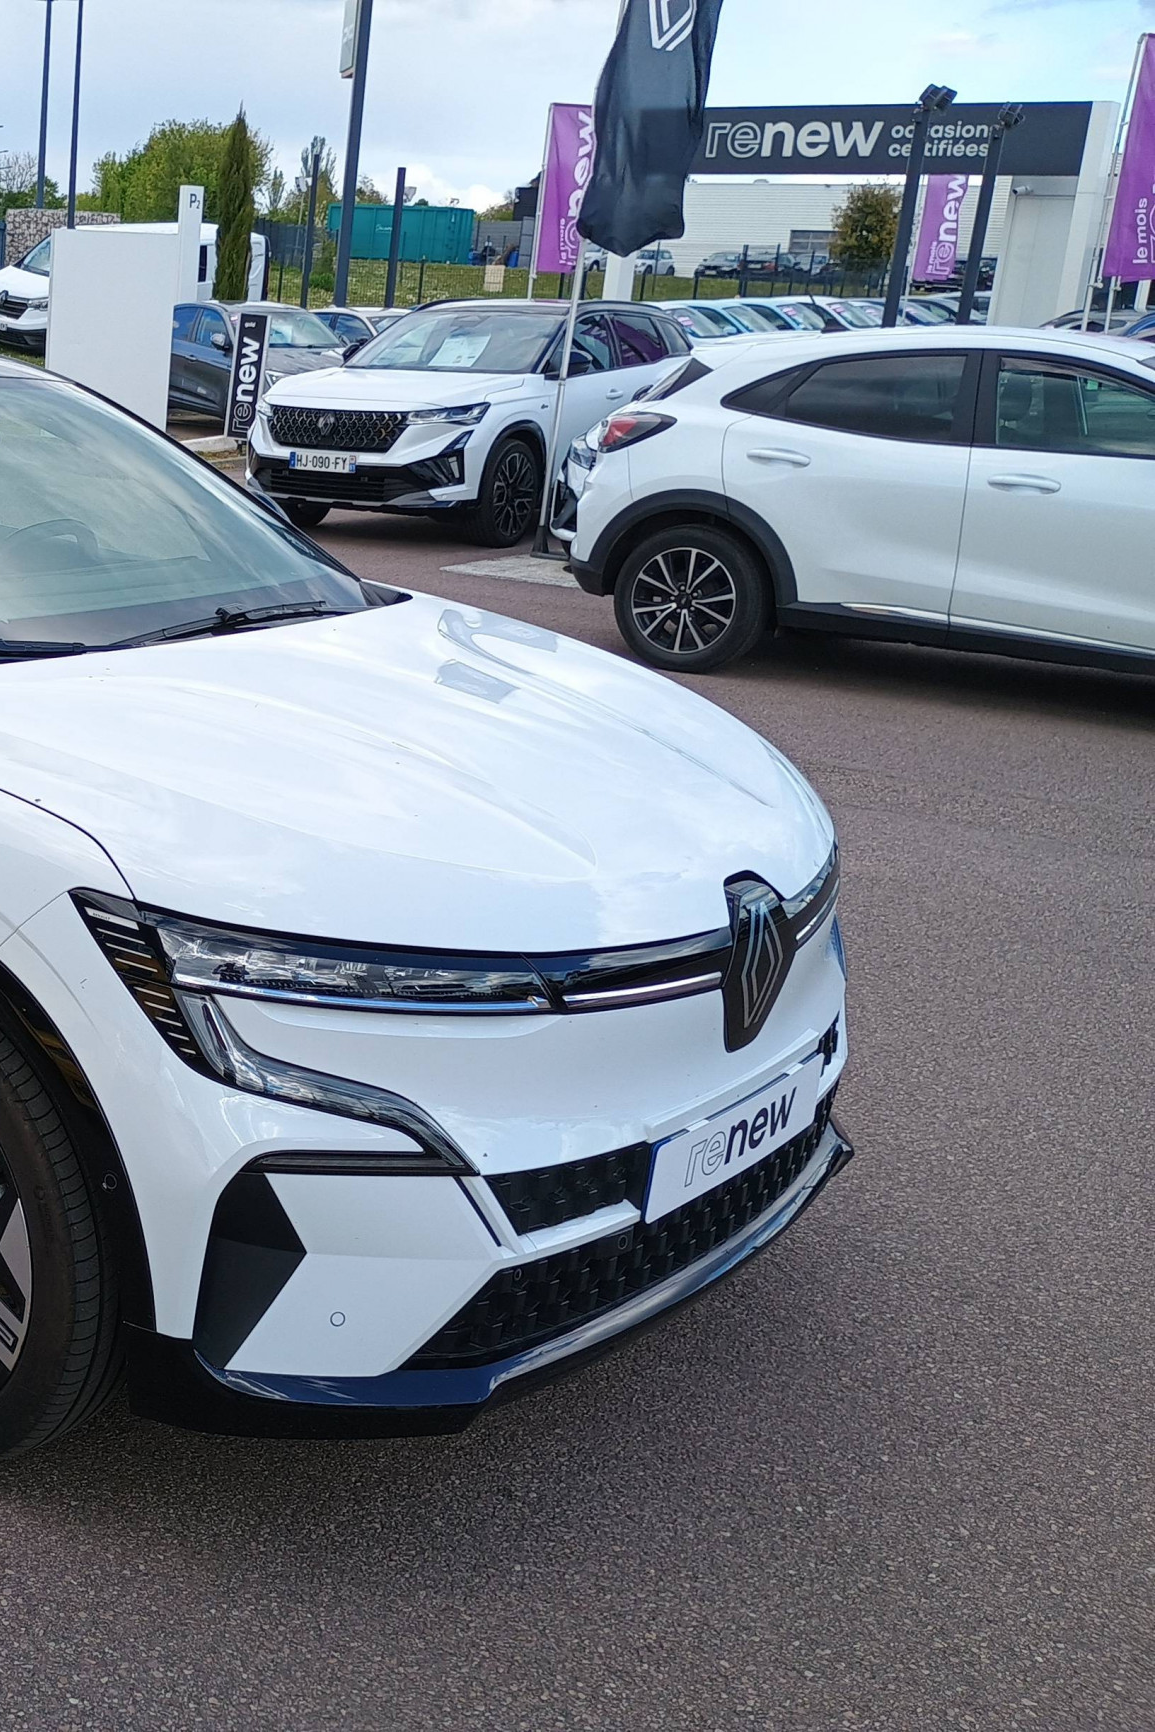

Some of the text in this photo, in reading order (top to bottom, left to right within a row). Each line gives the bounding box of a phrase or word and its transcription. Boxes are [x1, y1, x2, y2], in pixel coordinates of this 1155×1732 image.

[705, 120, 885, 158] renew
[888, 139, 990, 157] cetifiées
[891, 120, 992, 139] ocasion
[931, 174, 966, 275] renew
[1132, 197, 1148, 264] le mois
[232, 336, 261, 433] renew
[296, 454, 348, 470] HJ-090-FY
[684, 1086, 797, 1188] renew
